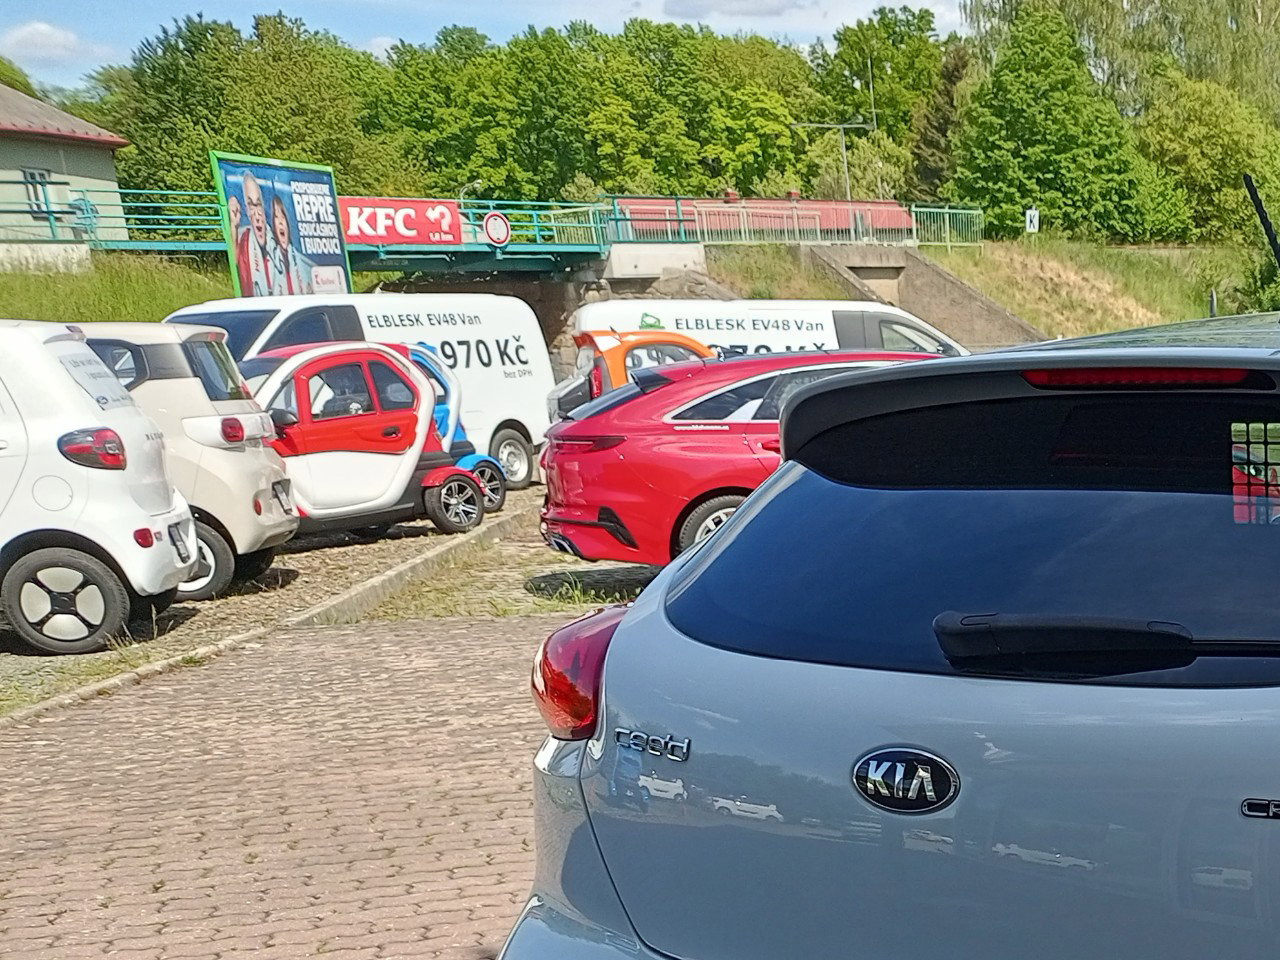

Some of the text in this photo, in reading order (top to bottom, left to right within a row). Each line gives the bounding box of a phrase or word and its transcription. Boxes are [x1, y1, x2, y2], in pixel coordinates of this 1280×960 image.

[292, 193, 337, 223] REPRE
[346, 206, 418, 238] KFC
[1029, 213, 1036, 229] K
[367, 313, 481, 328] ELBLESK EV48 Van
[676, 318, 824, 331] ELBLESK EV48 Van
[440, 335, 529, 369] 970 Kč
[866, 760, 938, 802] KIA
